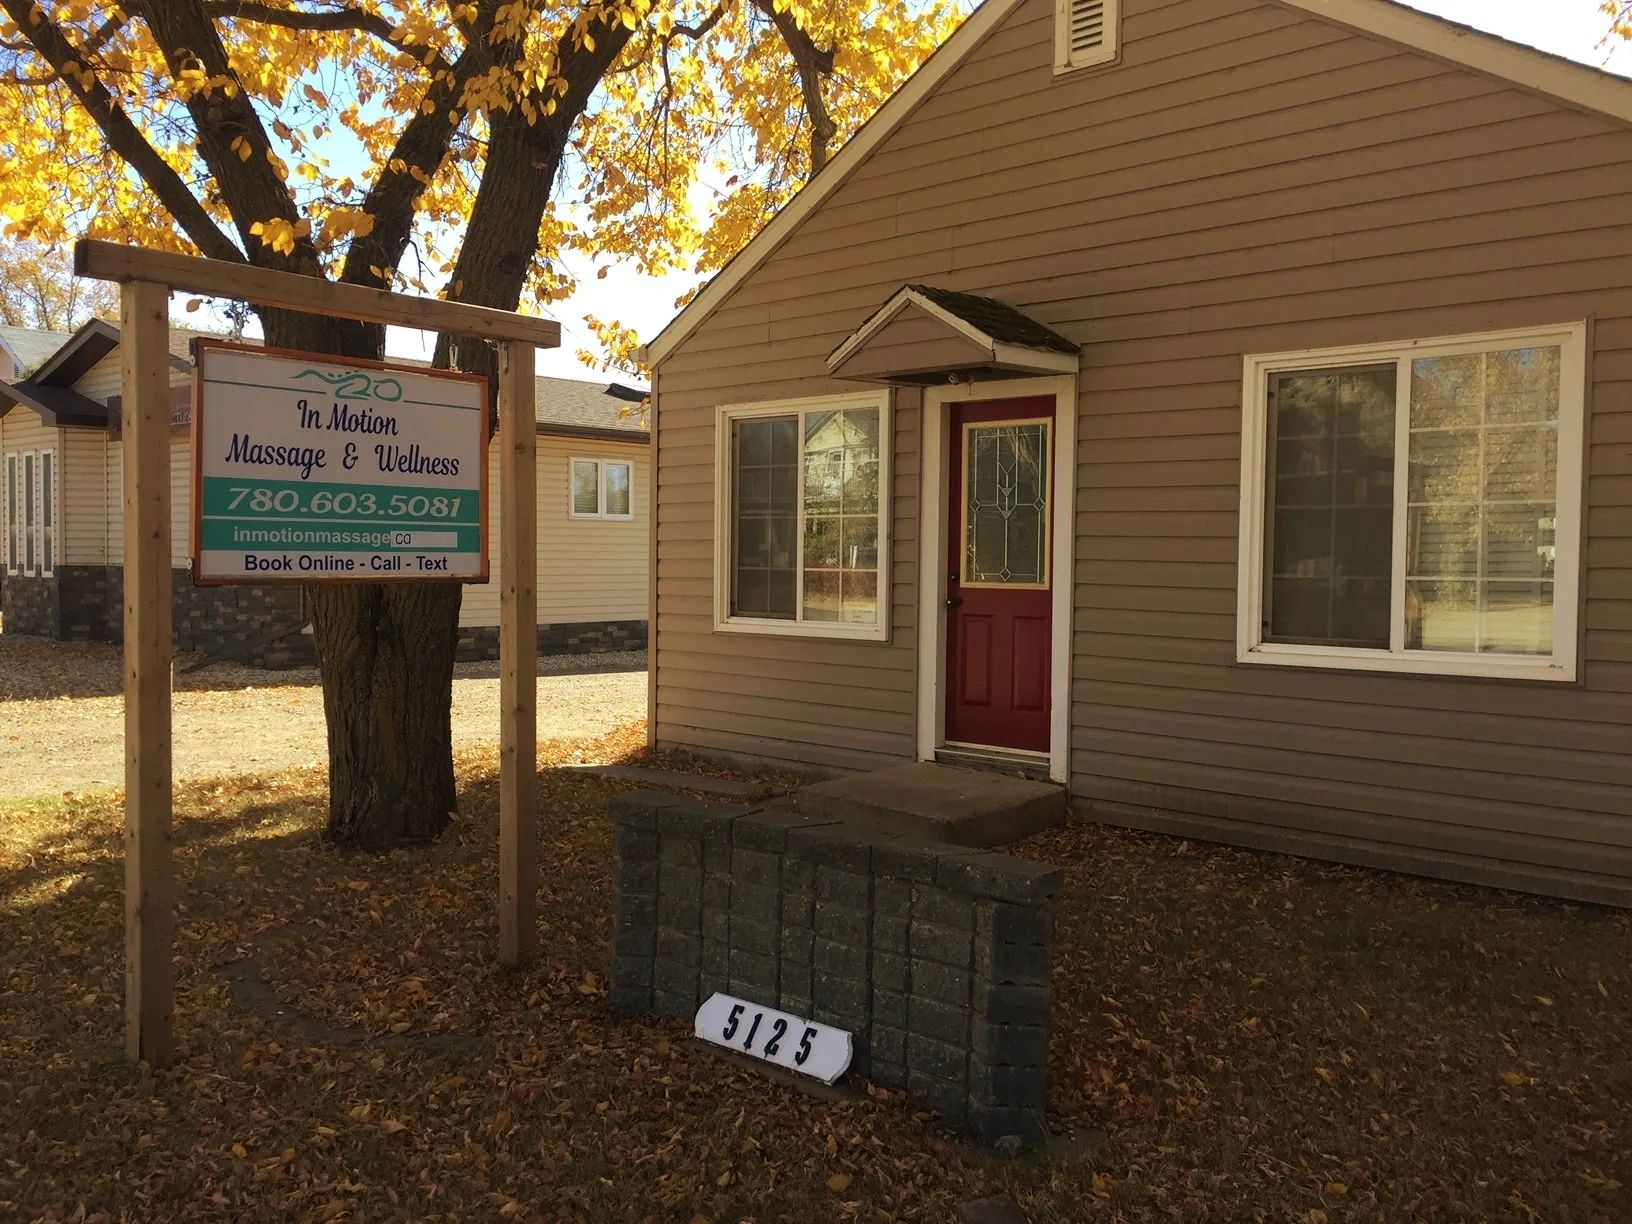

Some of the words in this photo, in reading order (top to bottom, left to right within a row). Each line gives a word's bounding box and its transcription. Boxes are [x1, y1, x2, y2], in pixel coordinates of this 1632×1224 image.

[297, 399, 323, 430] In
[326, 403, 399, 436] Motion
[225, 433, 327, 480] Massage
[342, 442, 359, 470] &
[374, 444, 460, 476] Wellness
[226, 487, 461, 518] 780.603.5081
[245, 554, 293, 571] Book
[298, 555, 355, 571] Online
[370, 556, 401, 571] Call
[416, 556, 448, 571] Text
[722, 1004, 818, 1066] 5125
